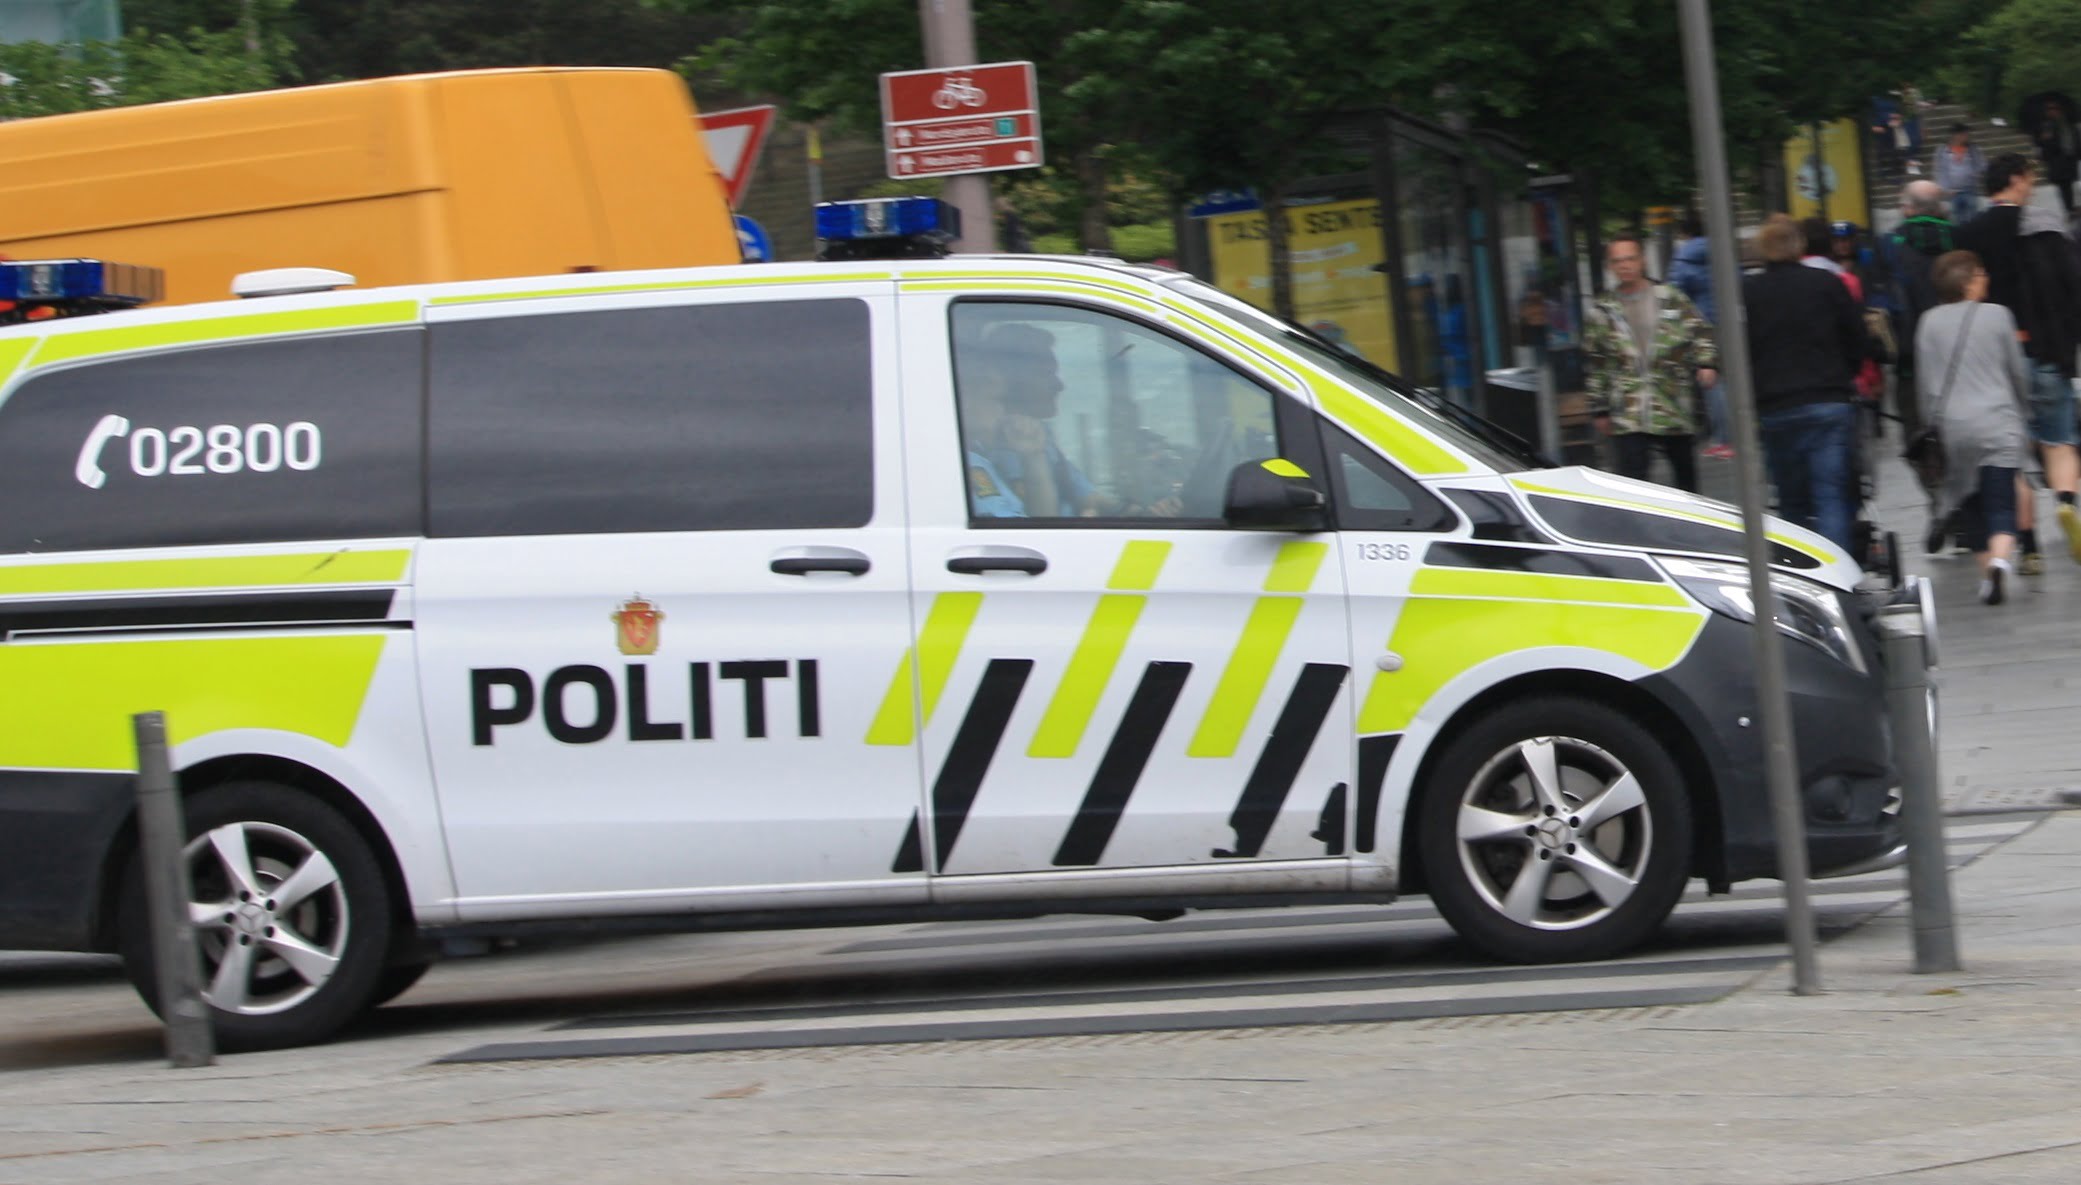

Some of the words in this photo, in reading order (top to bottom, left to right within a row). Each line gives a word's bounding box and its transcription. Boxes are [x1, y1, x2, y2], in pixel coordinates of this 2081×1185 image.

[130, 421, 321, 477] 02800
[1357, 543, 1411, 561] 1336
[470, 658, 822, 746] POLITI
